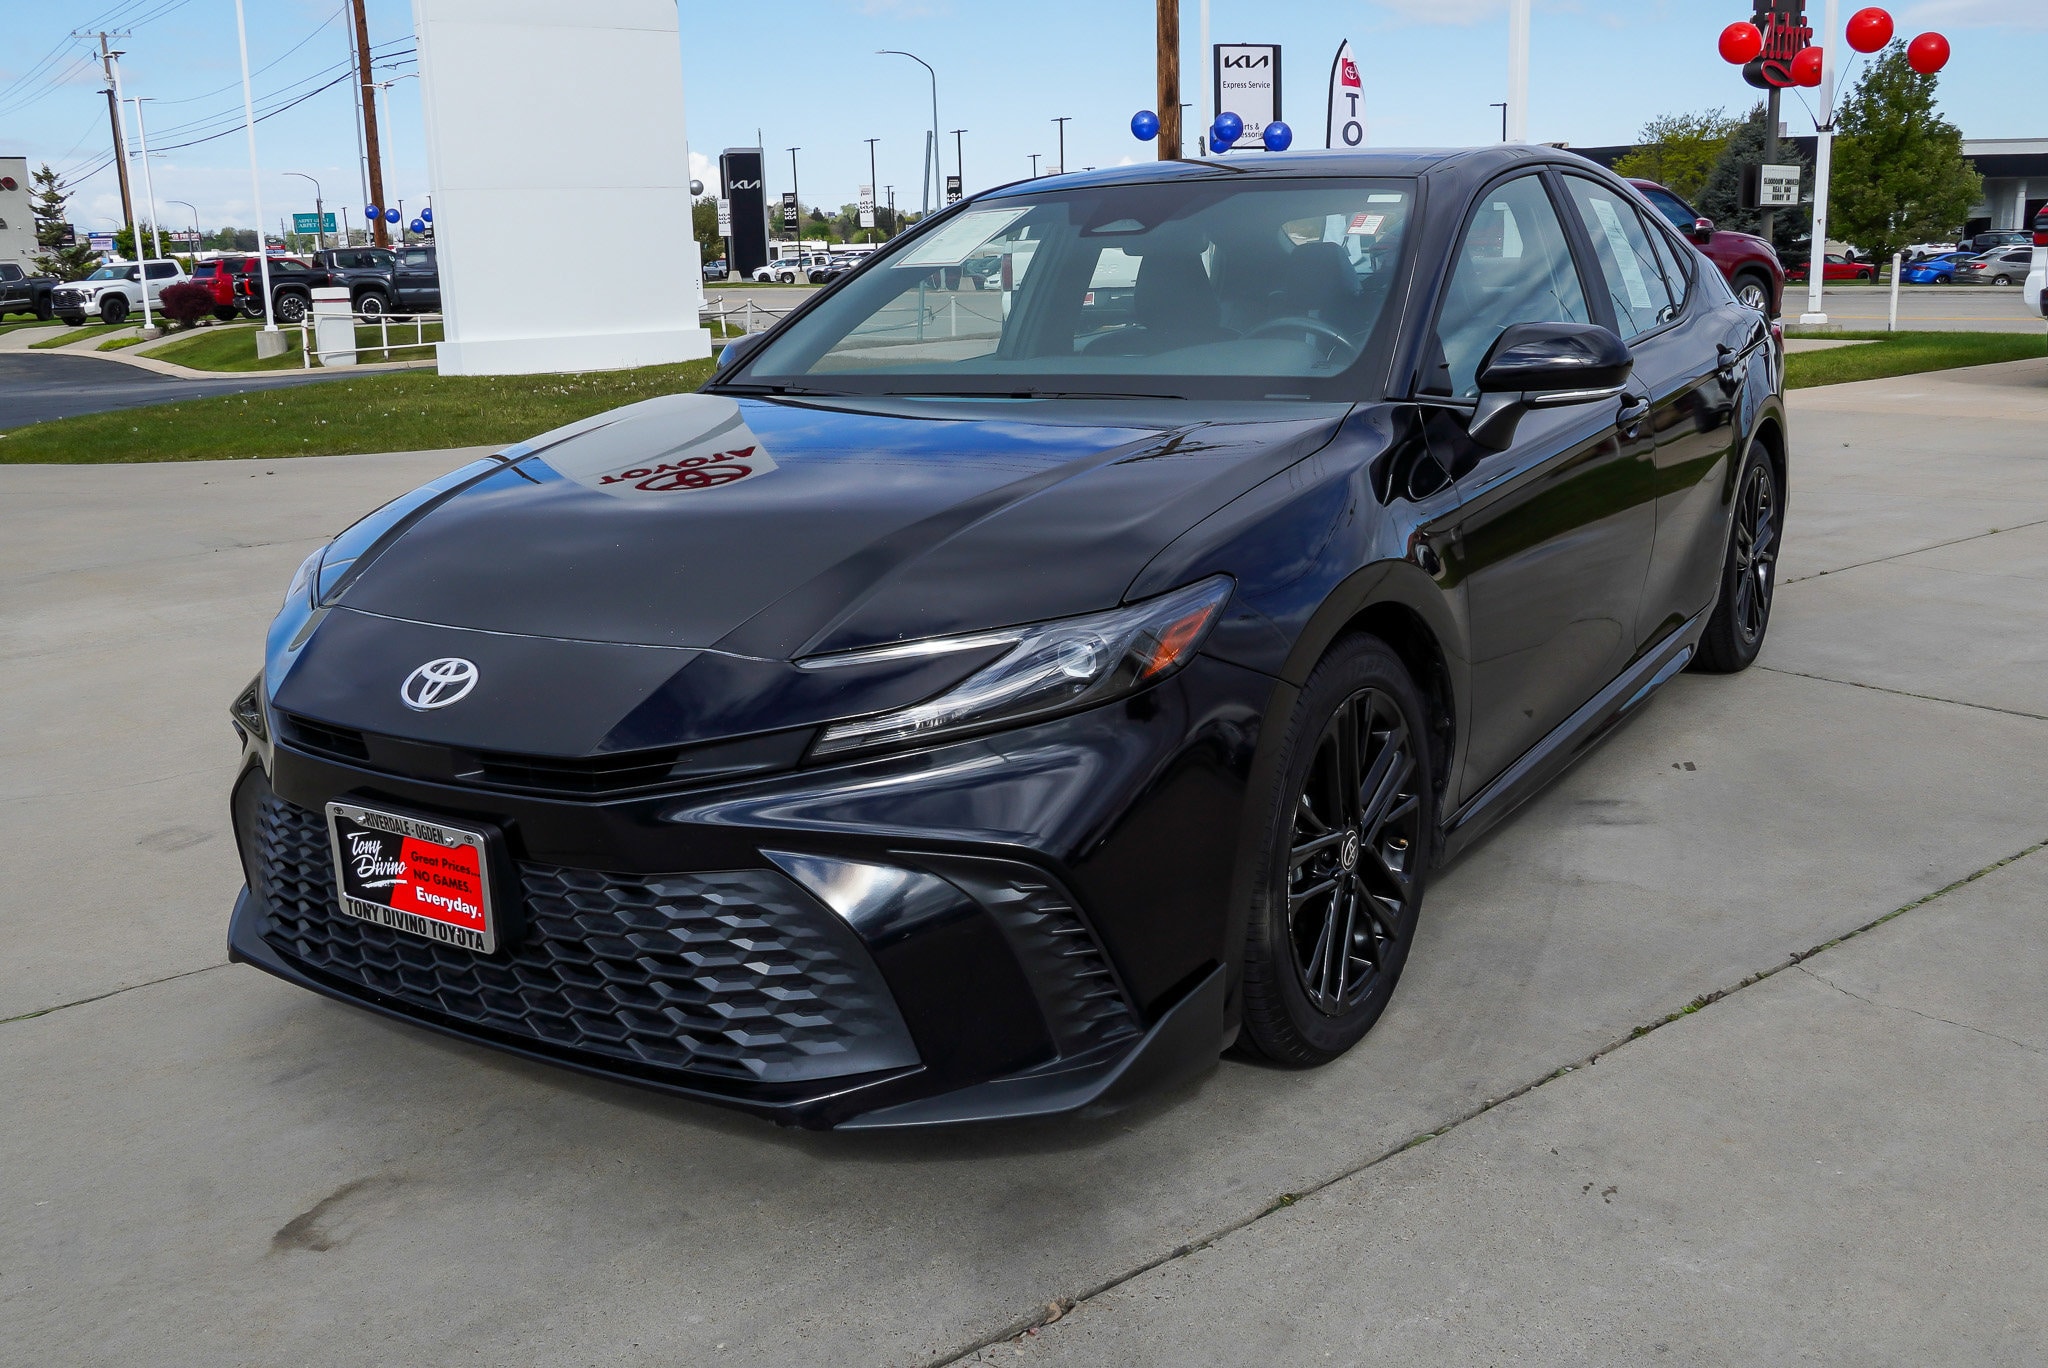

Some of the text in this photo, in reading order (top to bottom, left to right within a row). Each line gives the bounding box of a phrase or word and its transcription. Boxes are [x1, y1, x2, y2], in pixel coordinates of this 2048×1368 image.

[1224, 55, 1269, 69] KIA
[1223, 81, 1271, 90] Express Service
[1255, 122, 1260, 130] &
[730, 179, 760, 190] KIA
[364, 812, 410, 836] RIVERDALE
[415, 823, 444, 844] OGDEN
[347, 831, 382, 856] Tony
[351, 854, 407, 878] Divino
[410, 851, 439, 868] Great
[413, 869, 473, 893] NO GAMES.
[415, 886, 482, 919] Everyday.
[346, 899, 485, 951] TONY DIVINO TOYOTA
